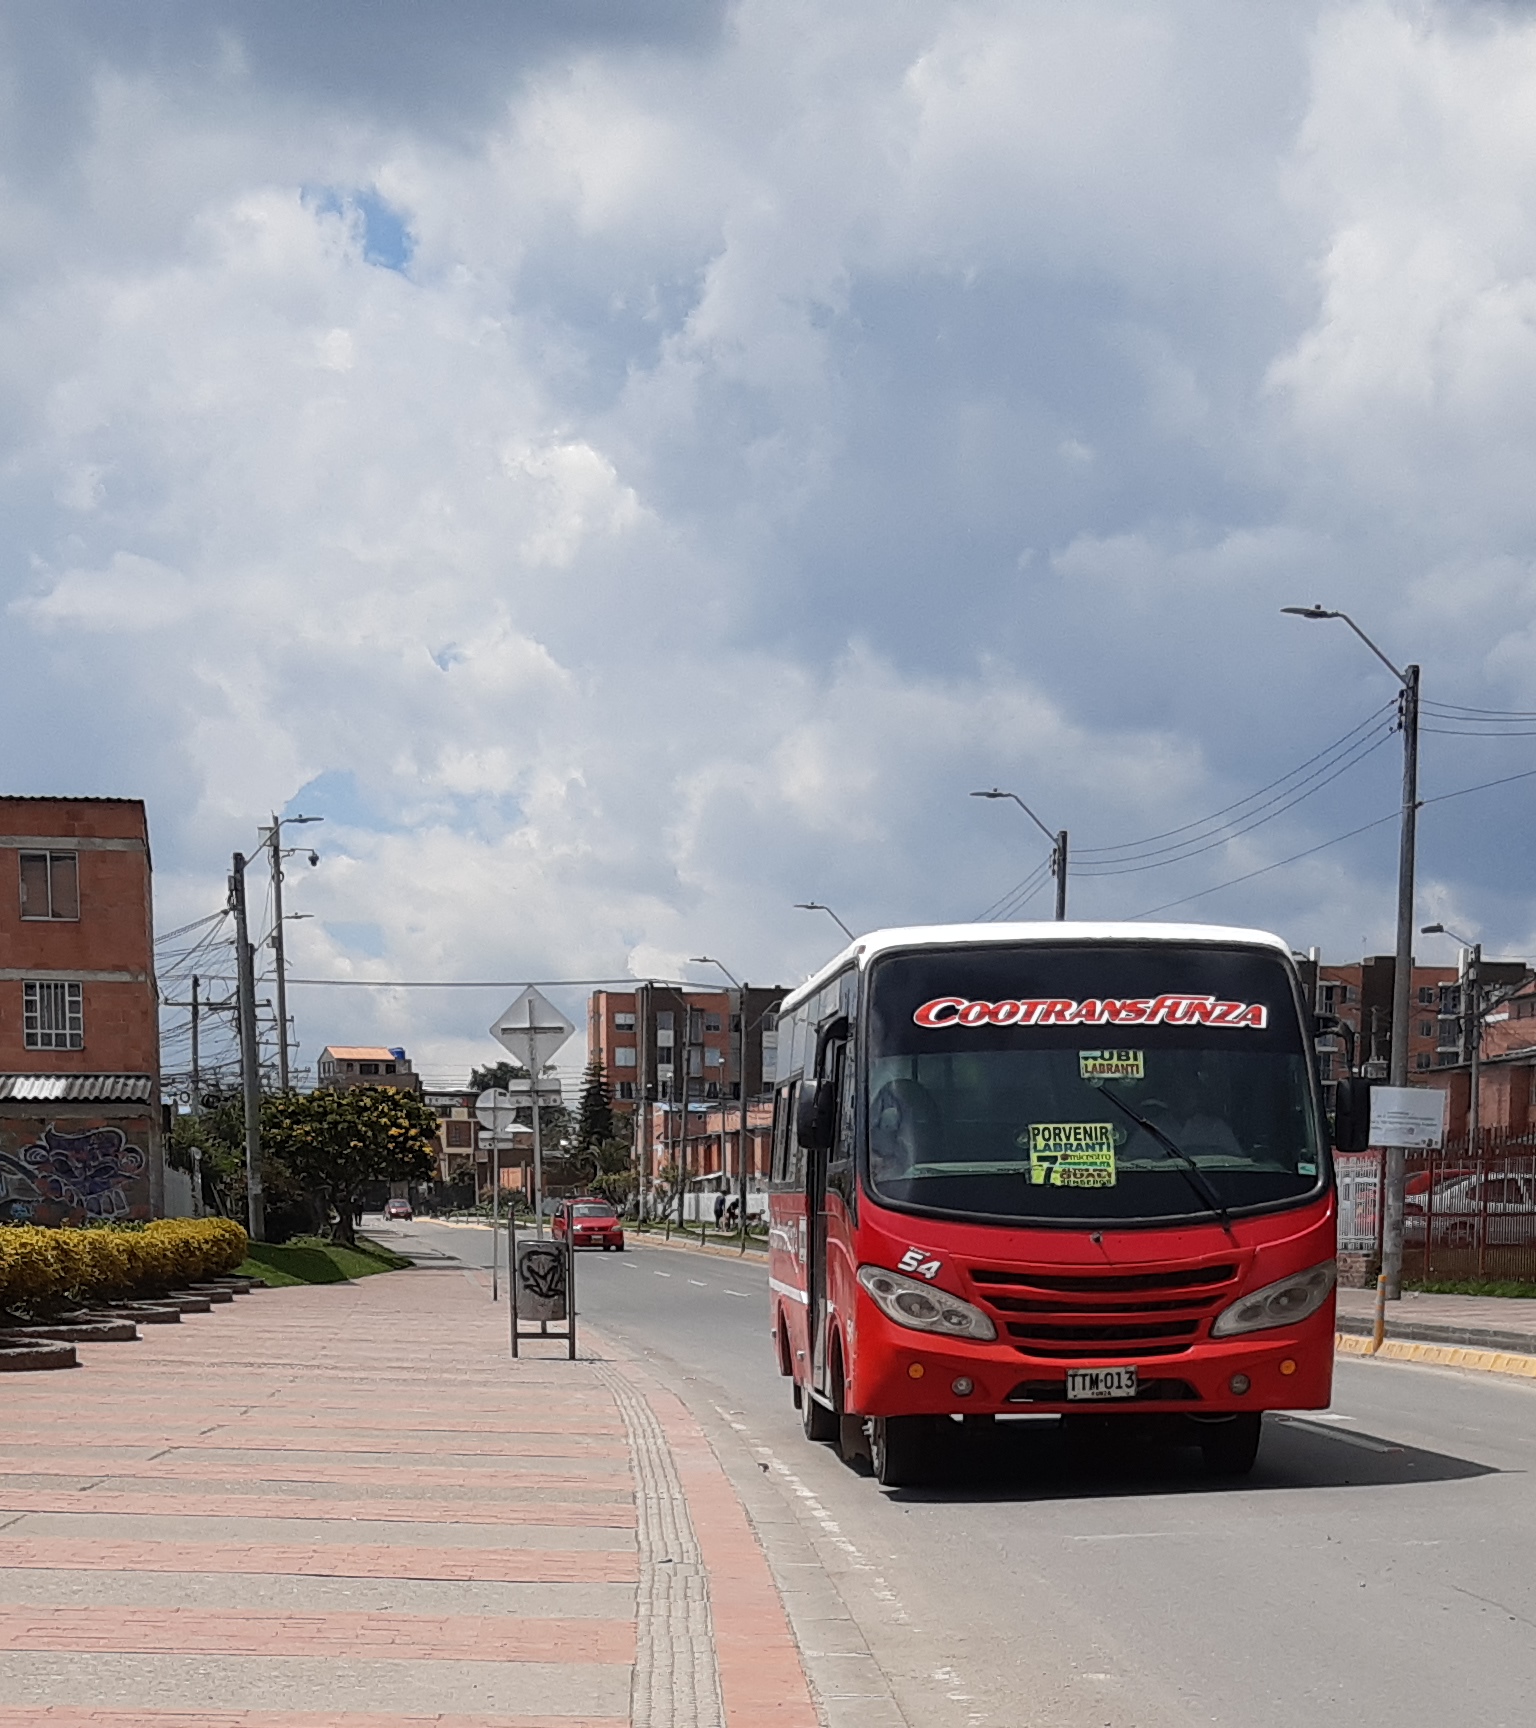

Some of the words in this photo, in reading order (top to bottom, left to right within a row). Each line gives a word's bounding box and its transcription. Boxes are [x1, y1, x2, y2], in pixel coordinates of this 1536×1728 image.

[913, 994, 1267, 1029] COOTRANSFUNZA
[1084, 1063, 1140, 1075] LABRANTI
[1031, 1126, 1110, 1142] PORVENIR
[1033, 1142, 1111, 1153] LABRANTI
[1036, 1155, 1059, 1184] 7
[897, 1250, 942, 1279] 54
